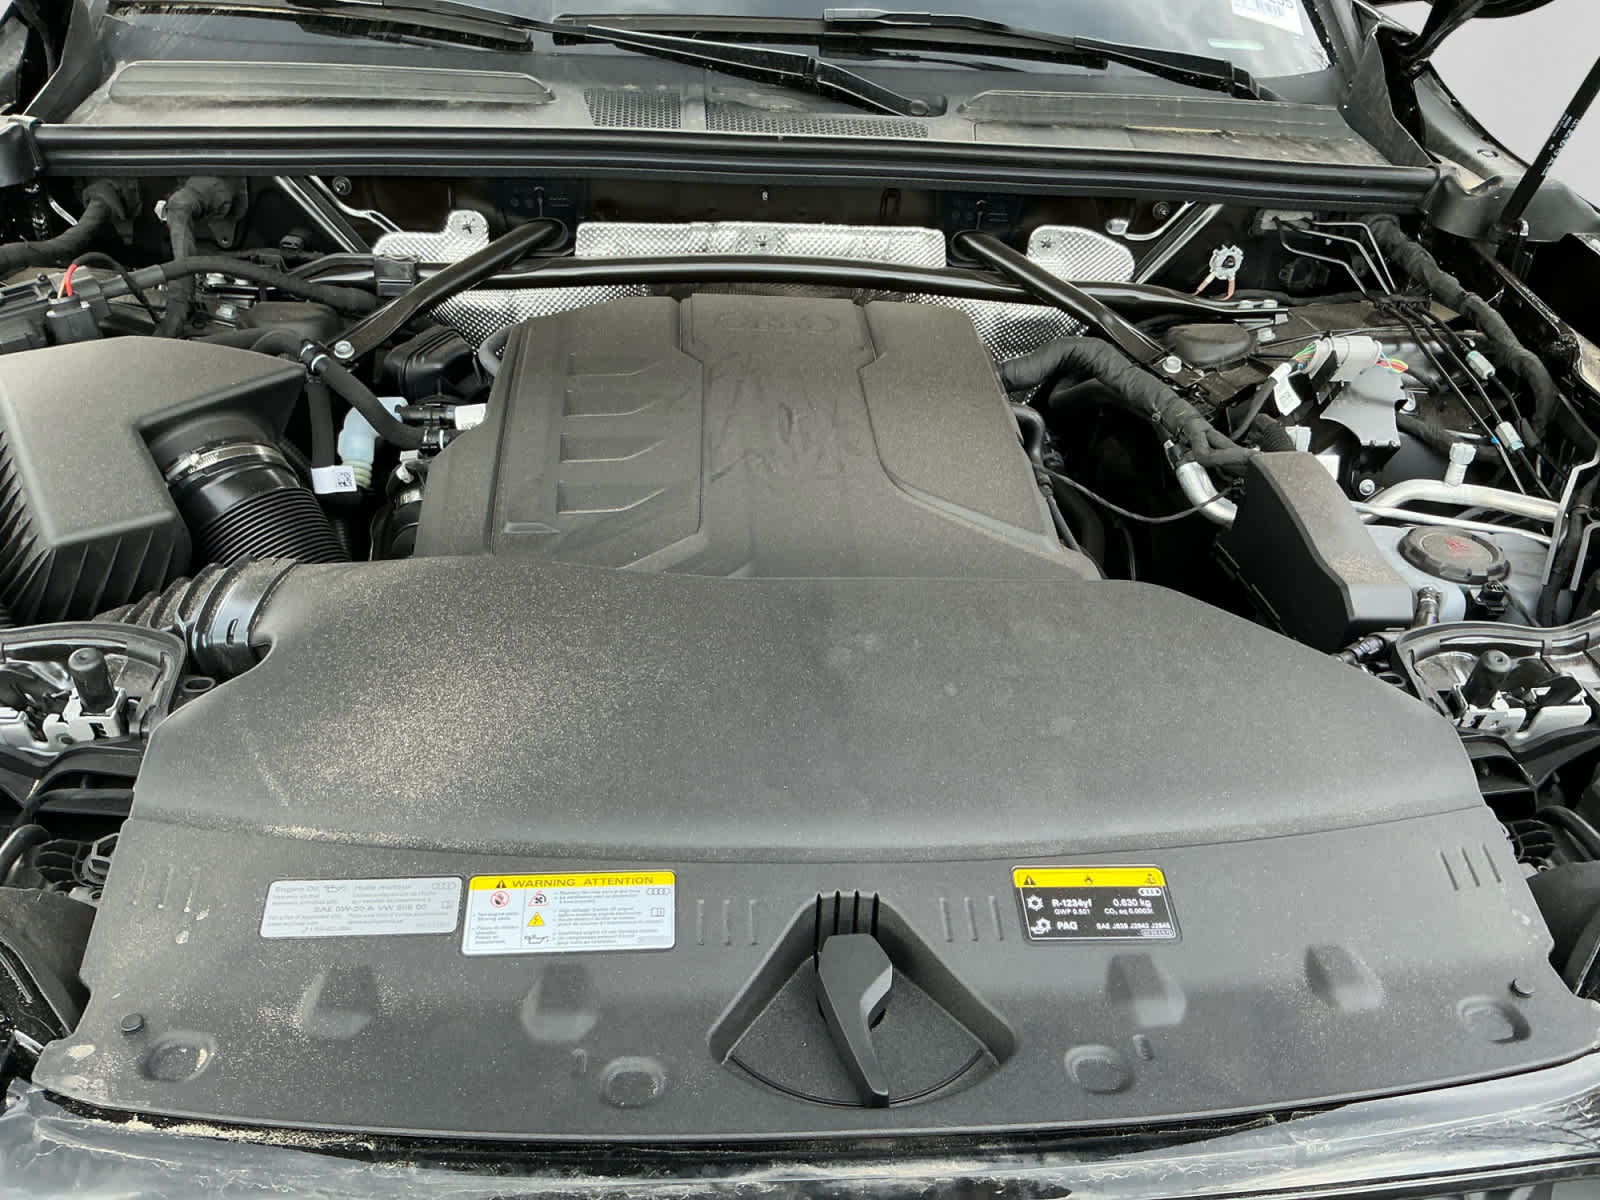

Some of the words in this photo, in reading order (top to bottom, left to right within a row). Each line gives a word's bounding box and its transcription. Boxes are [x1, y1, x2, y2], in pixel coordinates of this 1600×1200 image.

[511, 878, 576, 889] WARNING
[583, 876, 654, 887] ATTENTION
[1051, 898, 1092, 908] R-1234yf
[1139, 898, 1152, 908] kg
[1056, 920, 1078, 930] PAG
